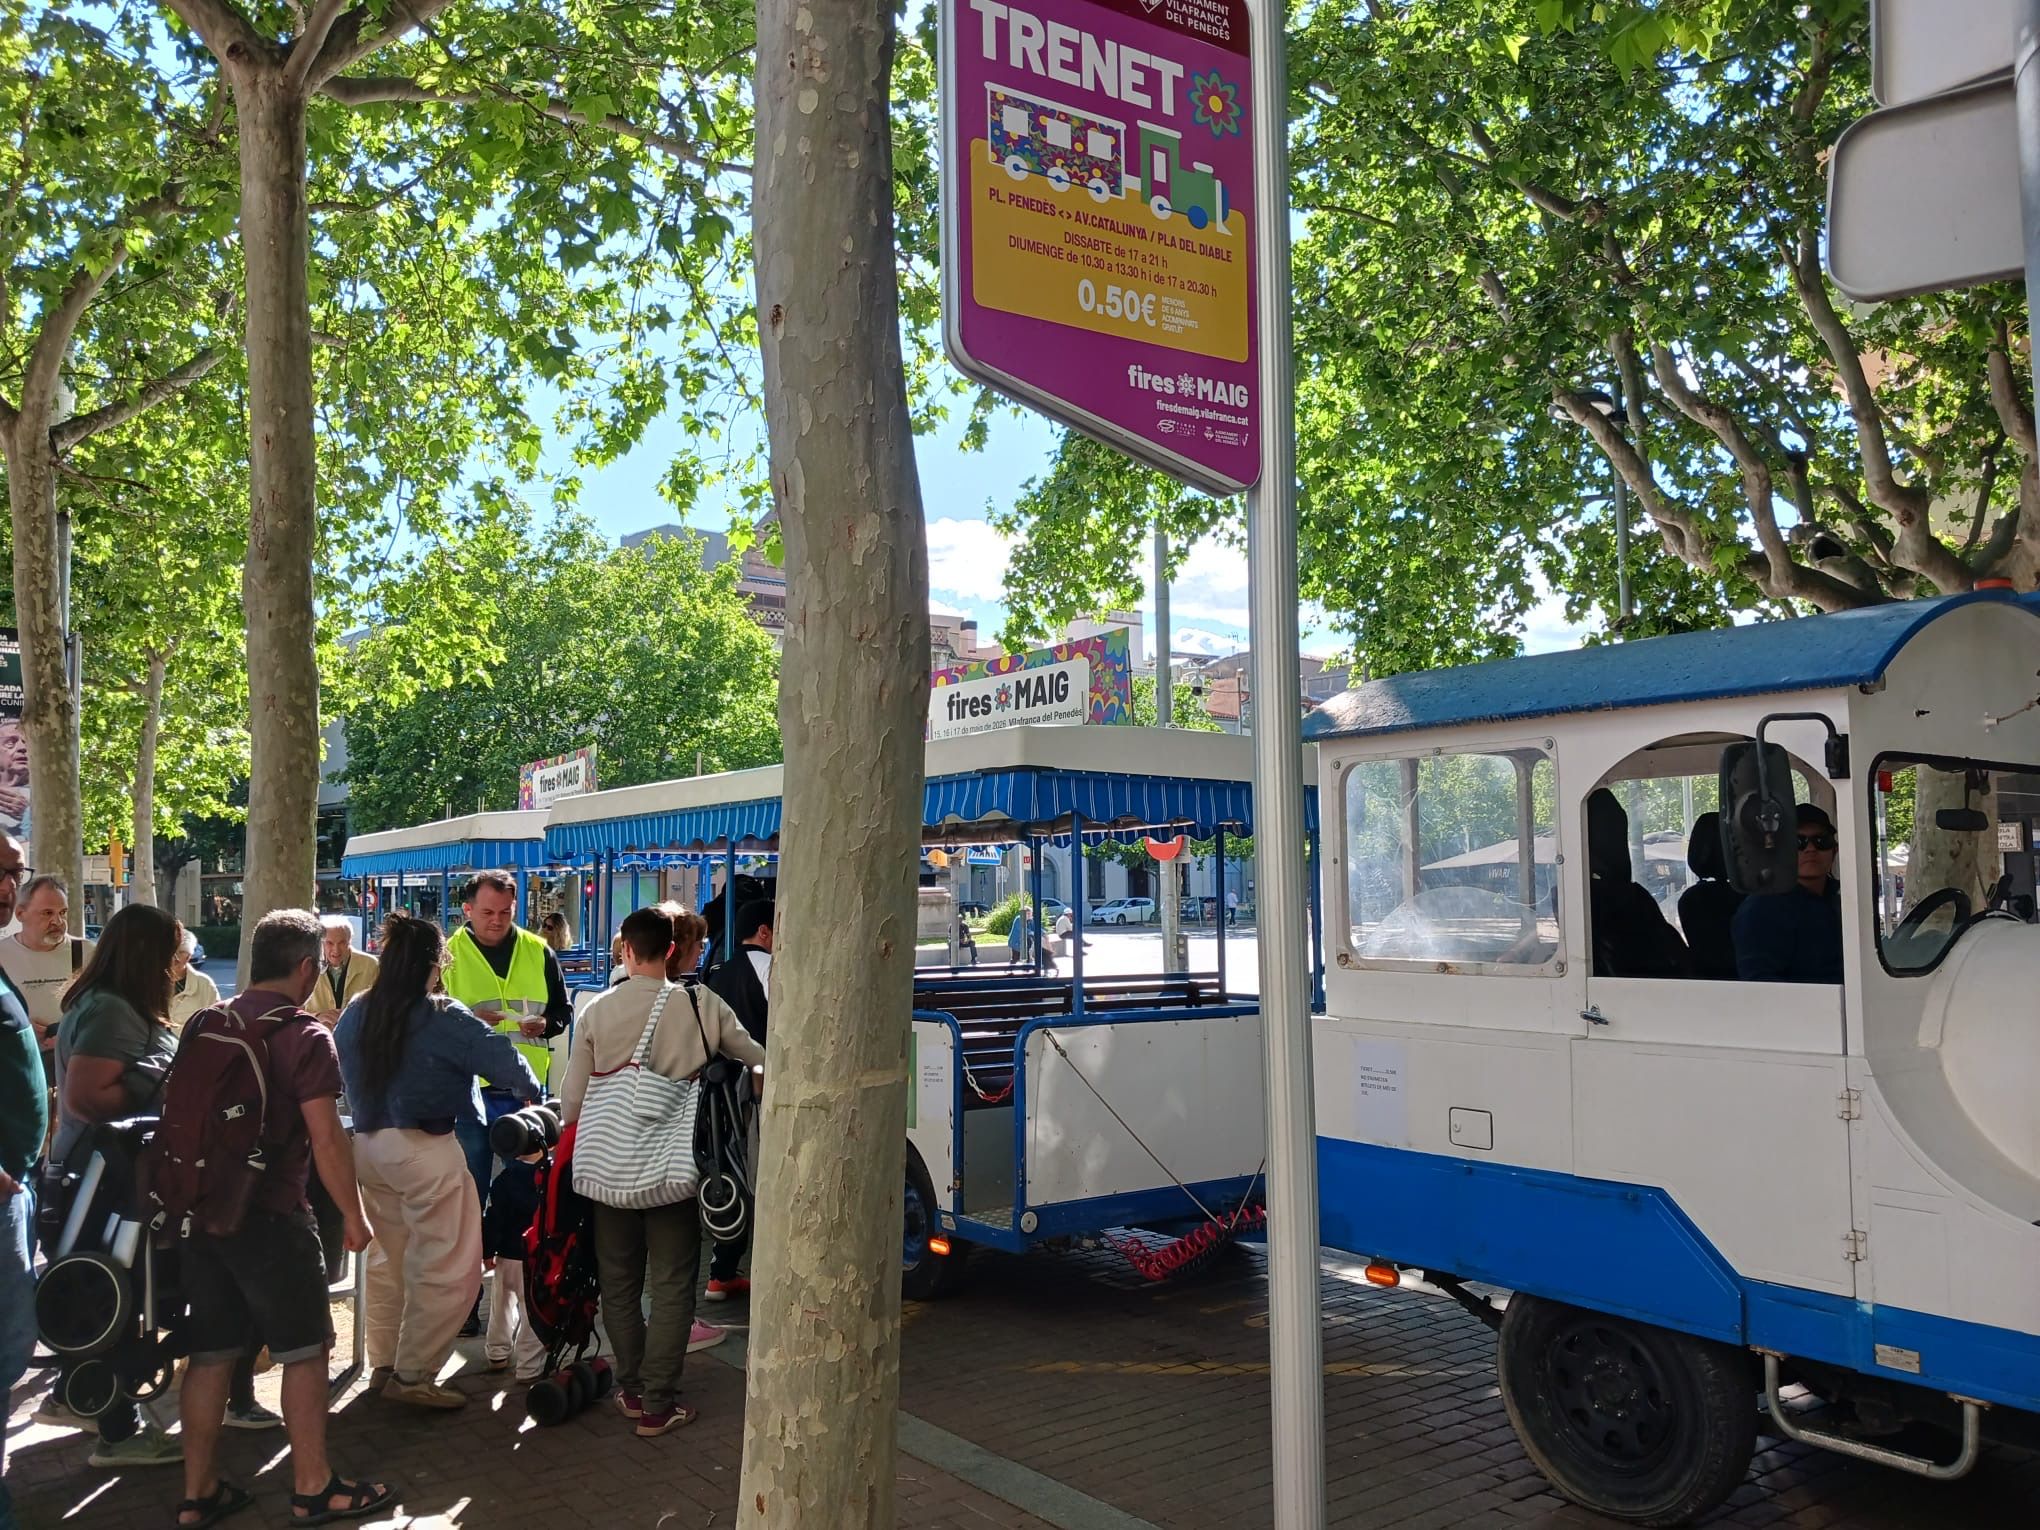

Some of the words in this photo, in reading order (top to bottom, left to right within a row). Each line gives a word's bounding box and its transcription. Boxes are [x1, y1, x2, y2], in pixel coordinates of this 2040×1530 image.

[1166, 10, 1184, 24] DEL
[1187, 17, 1230, 41] PENEDÈS
[970, 0, 1184, 116] TRENET
[989, 187, 1006, 204] PL.
[1008, 192, 1056, 217] PENEDÈS
[1157, 232, 1177, 248] PLA
[1179, 238, 1197, 254] DEL
[1199, 243, 1233, 263] DIABLE
[1008, 235, 1064, 260] DIUMENGE
[1066, 250, 1078, 264] de
[1080, 254, 1105, 271] 10.30
[1107, 263, 1113, 273] a
[1115, 262, 1139, 279] 13.30
[1141, 268, 1147, 281] h
[1154, 272, 1165, 285] de
[1168, 276, 1177, 288] 17
[1180, 281, 1185, 290] a
[1187, 280, 1210, 296] 20.30
[1211, 285, 1217, 298] h
[1064, 231, 1113, 255] DISSABTE
[1114, 245, 1126, 258] de
[1129, 248, 1138, 261] 17
[1141, 254, 1147, 264] a
[1149, 254, 1159, 267] 21
[1162, 256, 1168, 269] h
[1078, 278, 1156, 327] 0.50€
[1128, 364, 1176, 394] fires
[1197, 377, 1248, 408] MAIG
[1156, 399, 1249, 426] firesdemaig.vilafranca.cat
[947, 691, 992, 721] fires
[1014, 671, 1069, 710] MAIG
[1042, 712, 1053, 722] del
[540, 775, 556, 793] fires
[563, 765, 580, 788] MAIG
